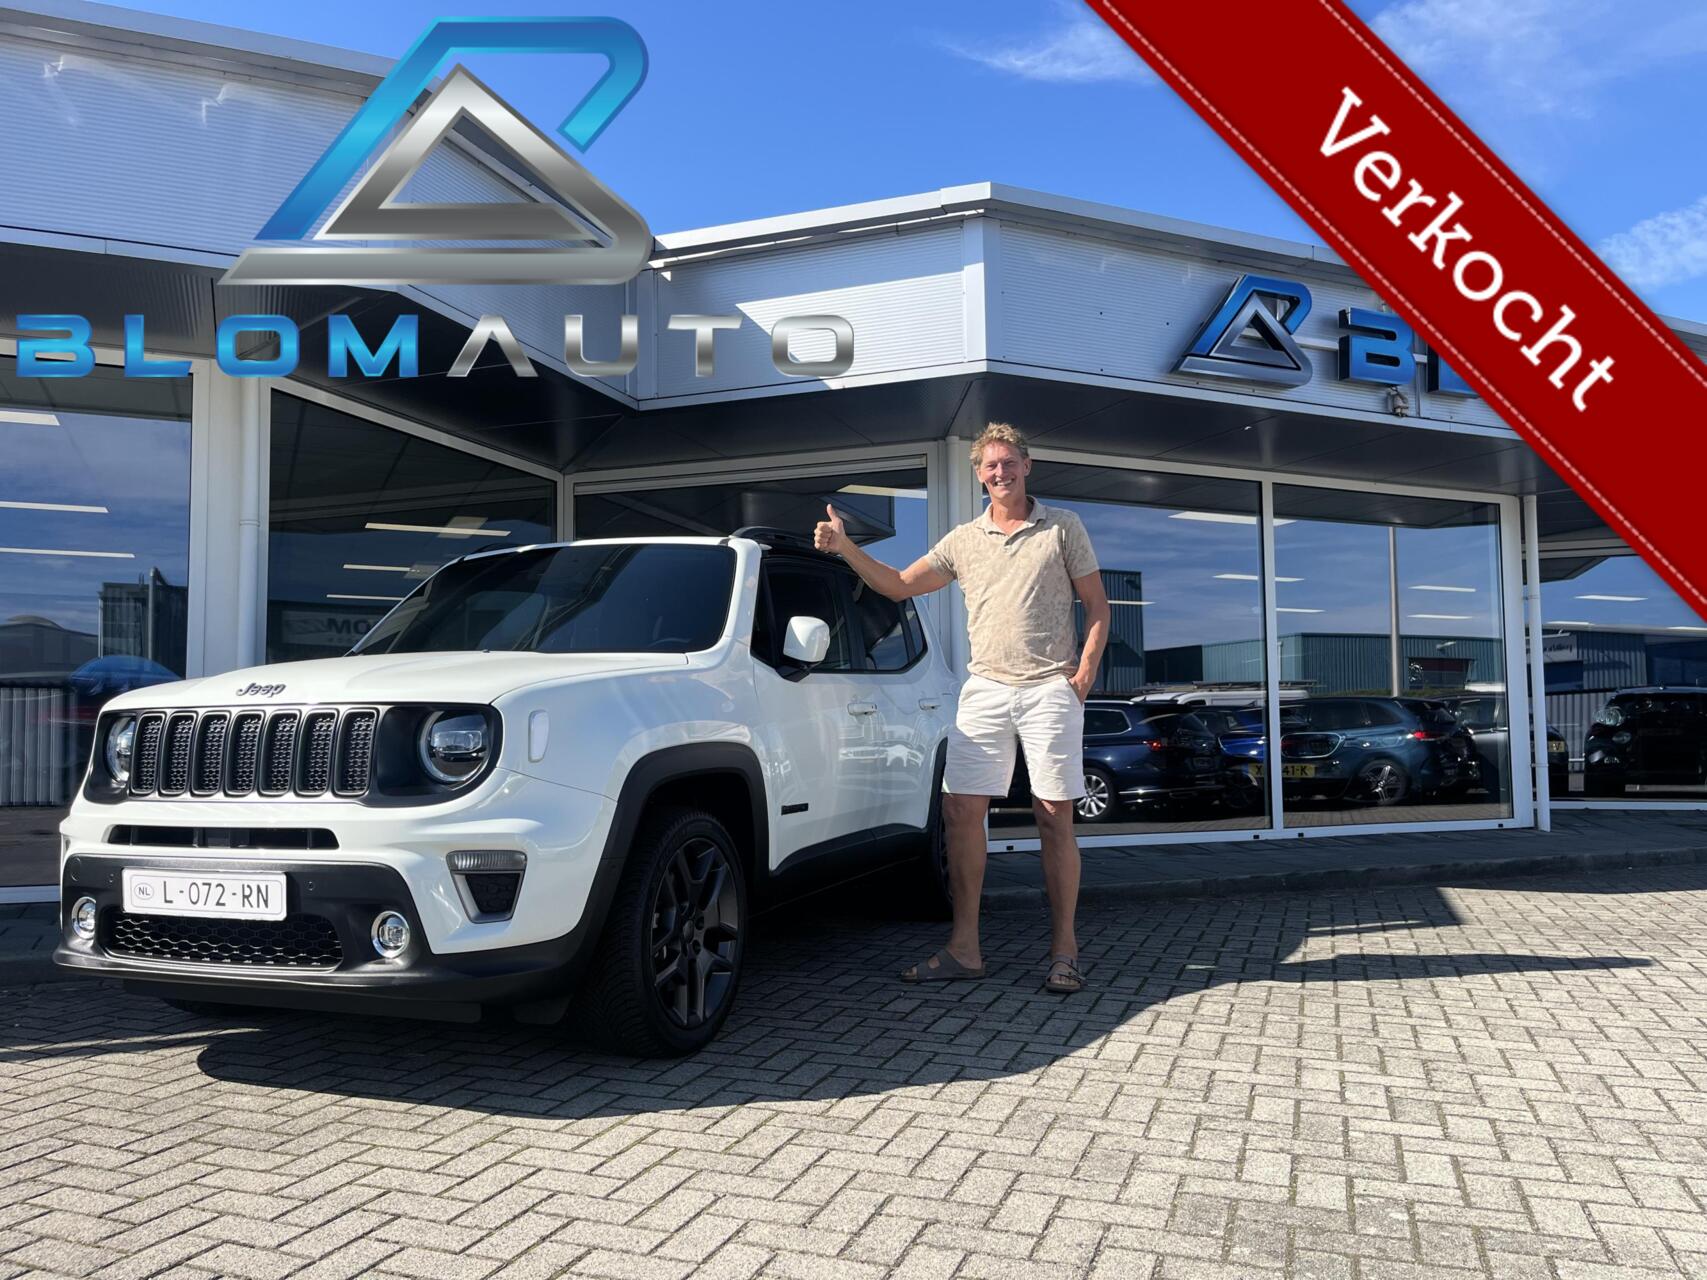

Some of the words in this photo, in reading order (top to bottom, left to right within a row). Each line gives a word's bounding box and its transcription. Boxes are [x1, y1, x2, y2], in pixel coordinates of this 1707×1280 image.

[235, 682, 287, 698] Jeep
[138, 887, 151, 896] NL
[163, 880, 269, 909] L-072-RN
